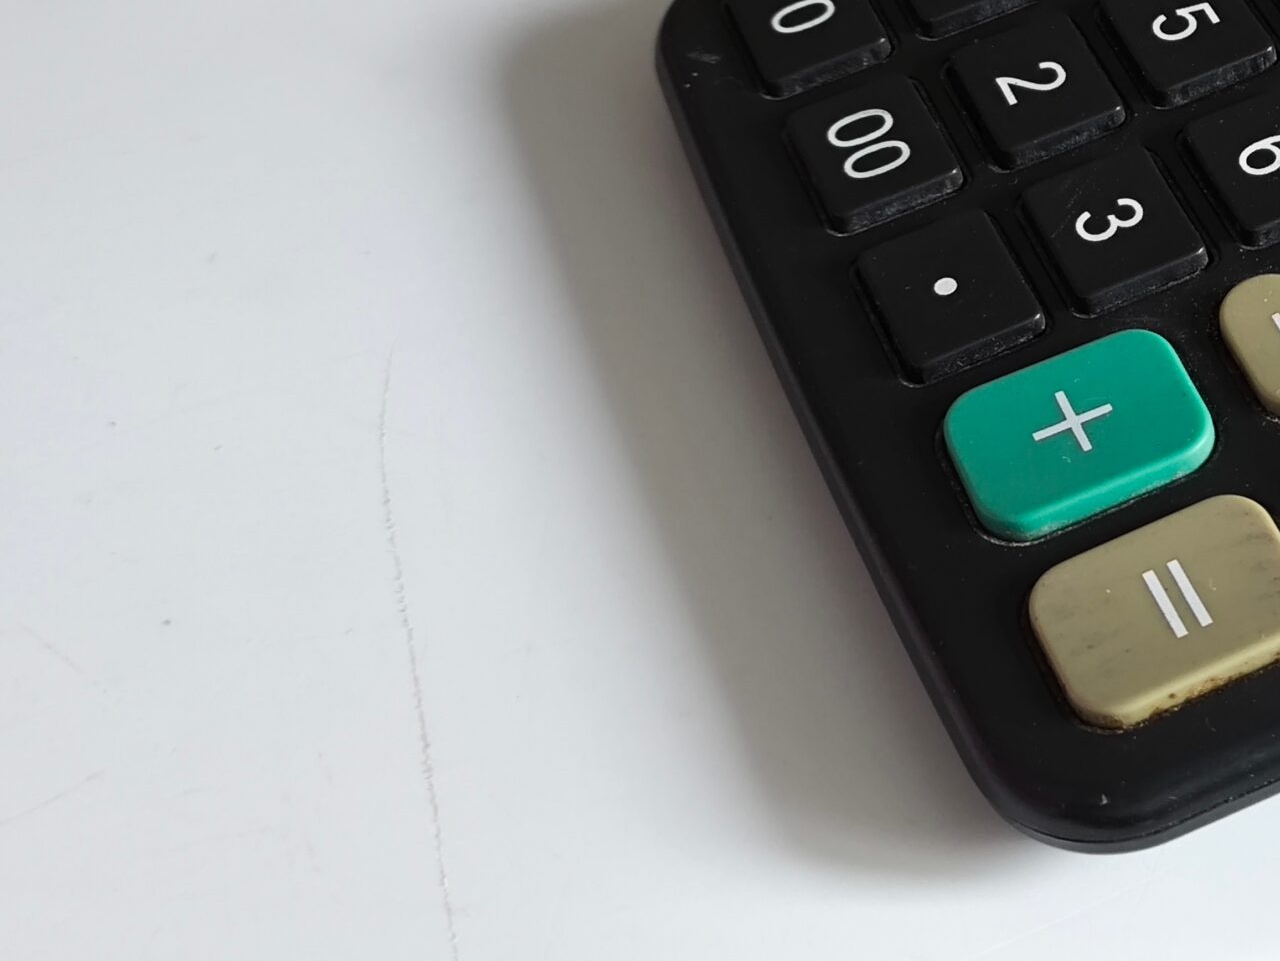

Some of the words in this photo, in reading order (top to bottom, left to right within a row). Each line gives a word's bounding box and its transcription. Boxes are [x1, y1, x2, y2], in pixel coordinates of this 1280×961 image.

[1152, 3, 1221, 41] 5
[995, 62, 1067, 105] 2
[827, 108, 911, 179] 00
[1075, 198, 1144, 242] 3
